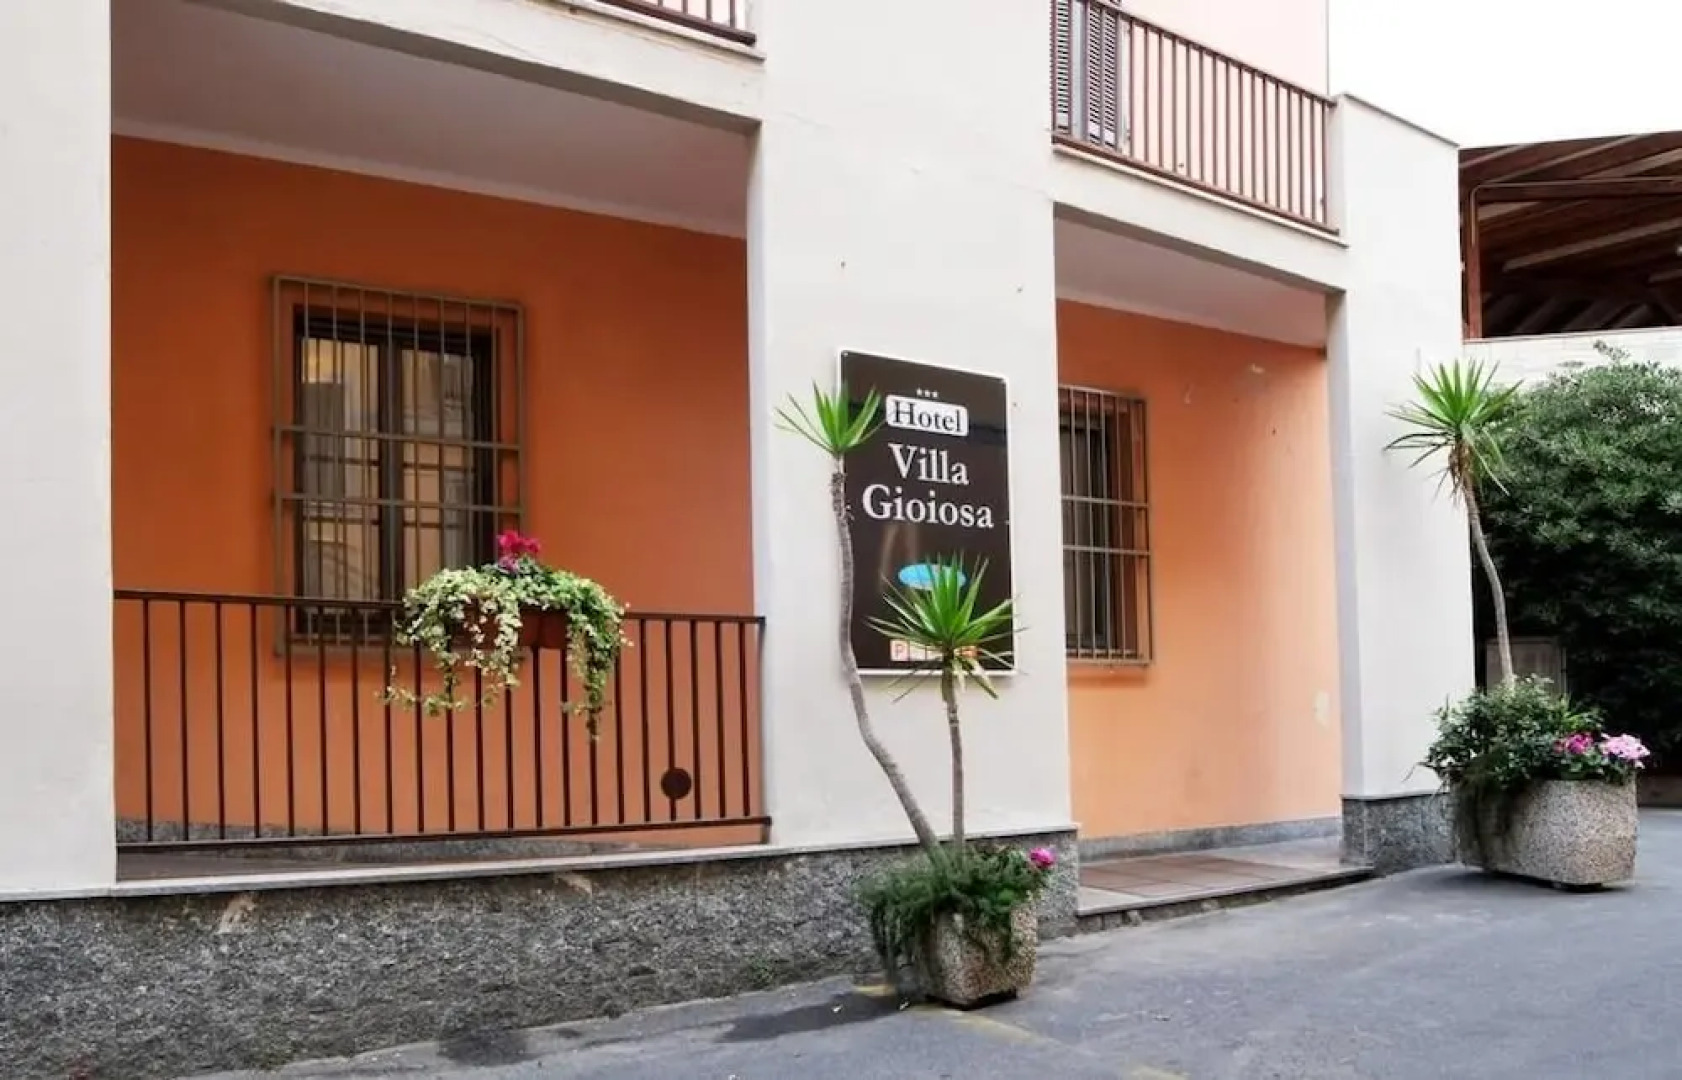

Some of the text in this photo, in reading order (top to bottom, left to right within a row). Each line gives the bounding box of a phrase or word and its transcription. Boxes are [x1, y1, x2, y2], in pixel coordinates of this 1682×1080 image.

[893, 401, 962, 432] Hotel
[888, 443, 969, 485] Villa
[862, 484, 994, 528] Gioiosa
